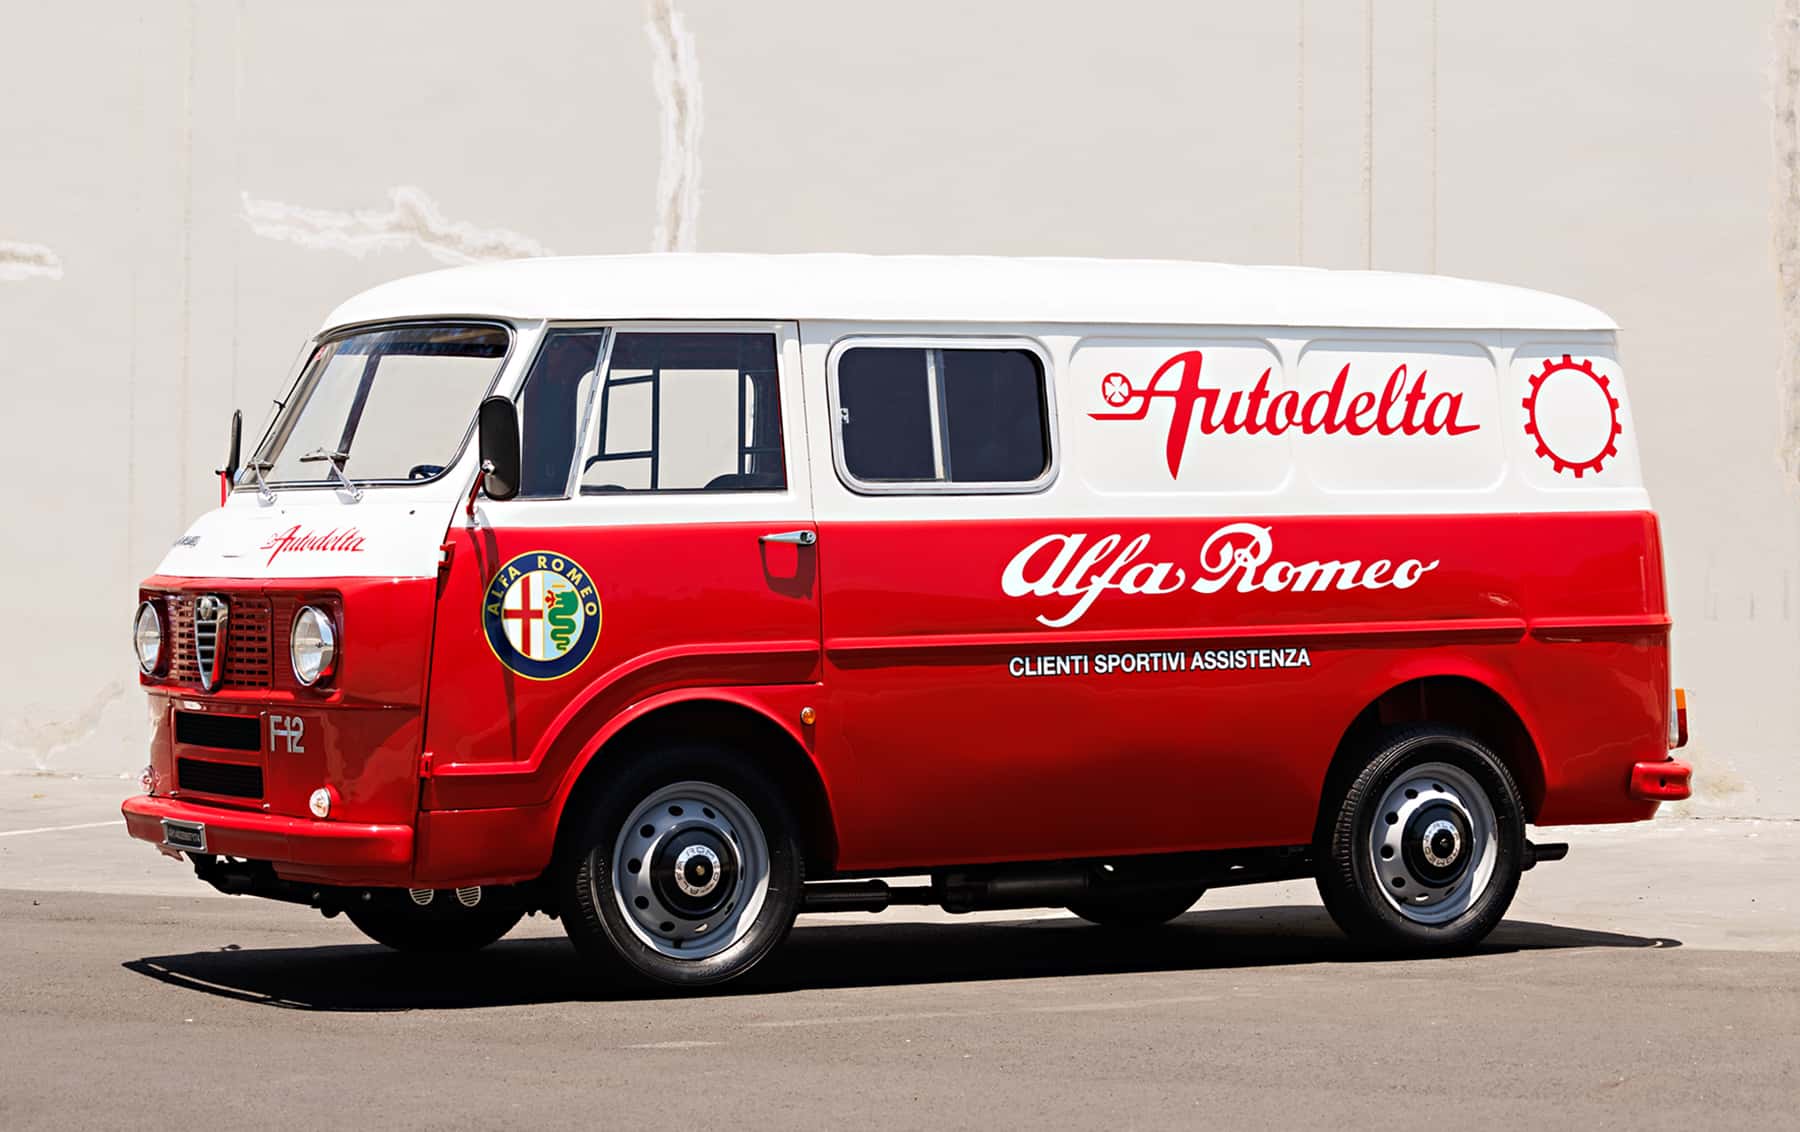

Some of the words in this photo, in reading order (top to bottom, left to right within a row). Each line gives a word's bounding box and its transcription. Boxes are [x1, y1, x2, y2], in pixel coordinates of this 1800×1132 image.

[1088, 350, 1481, 480] Autodelta
[260, 524, 366, 567] Autodelta
[1002, 533, 1186, 628] Alfa
[1191, 522, 1440, 594] Romeo
[487, 565, 521, 616] ALFA
[537, 555, 598, 617] ROMEO
[1009, 655, 1089, 677] CLIENTI
[1094, 652, 1186, 674] SPORTIVI
[1190, 648, 1311, 670] ASSISTENZA
